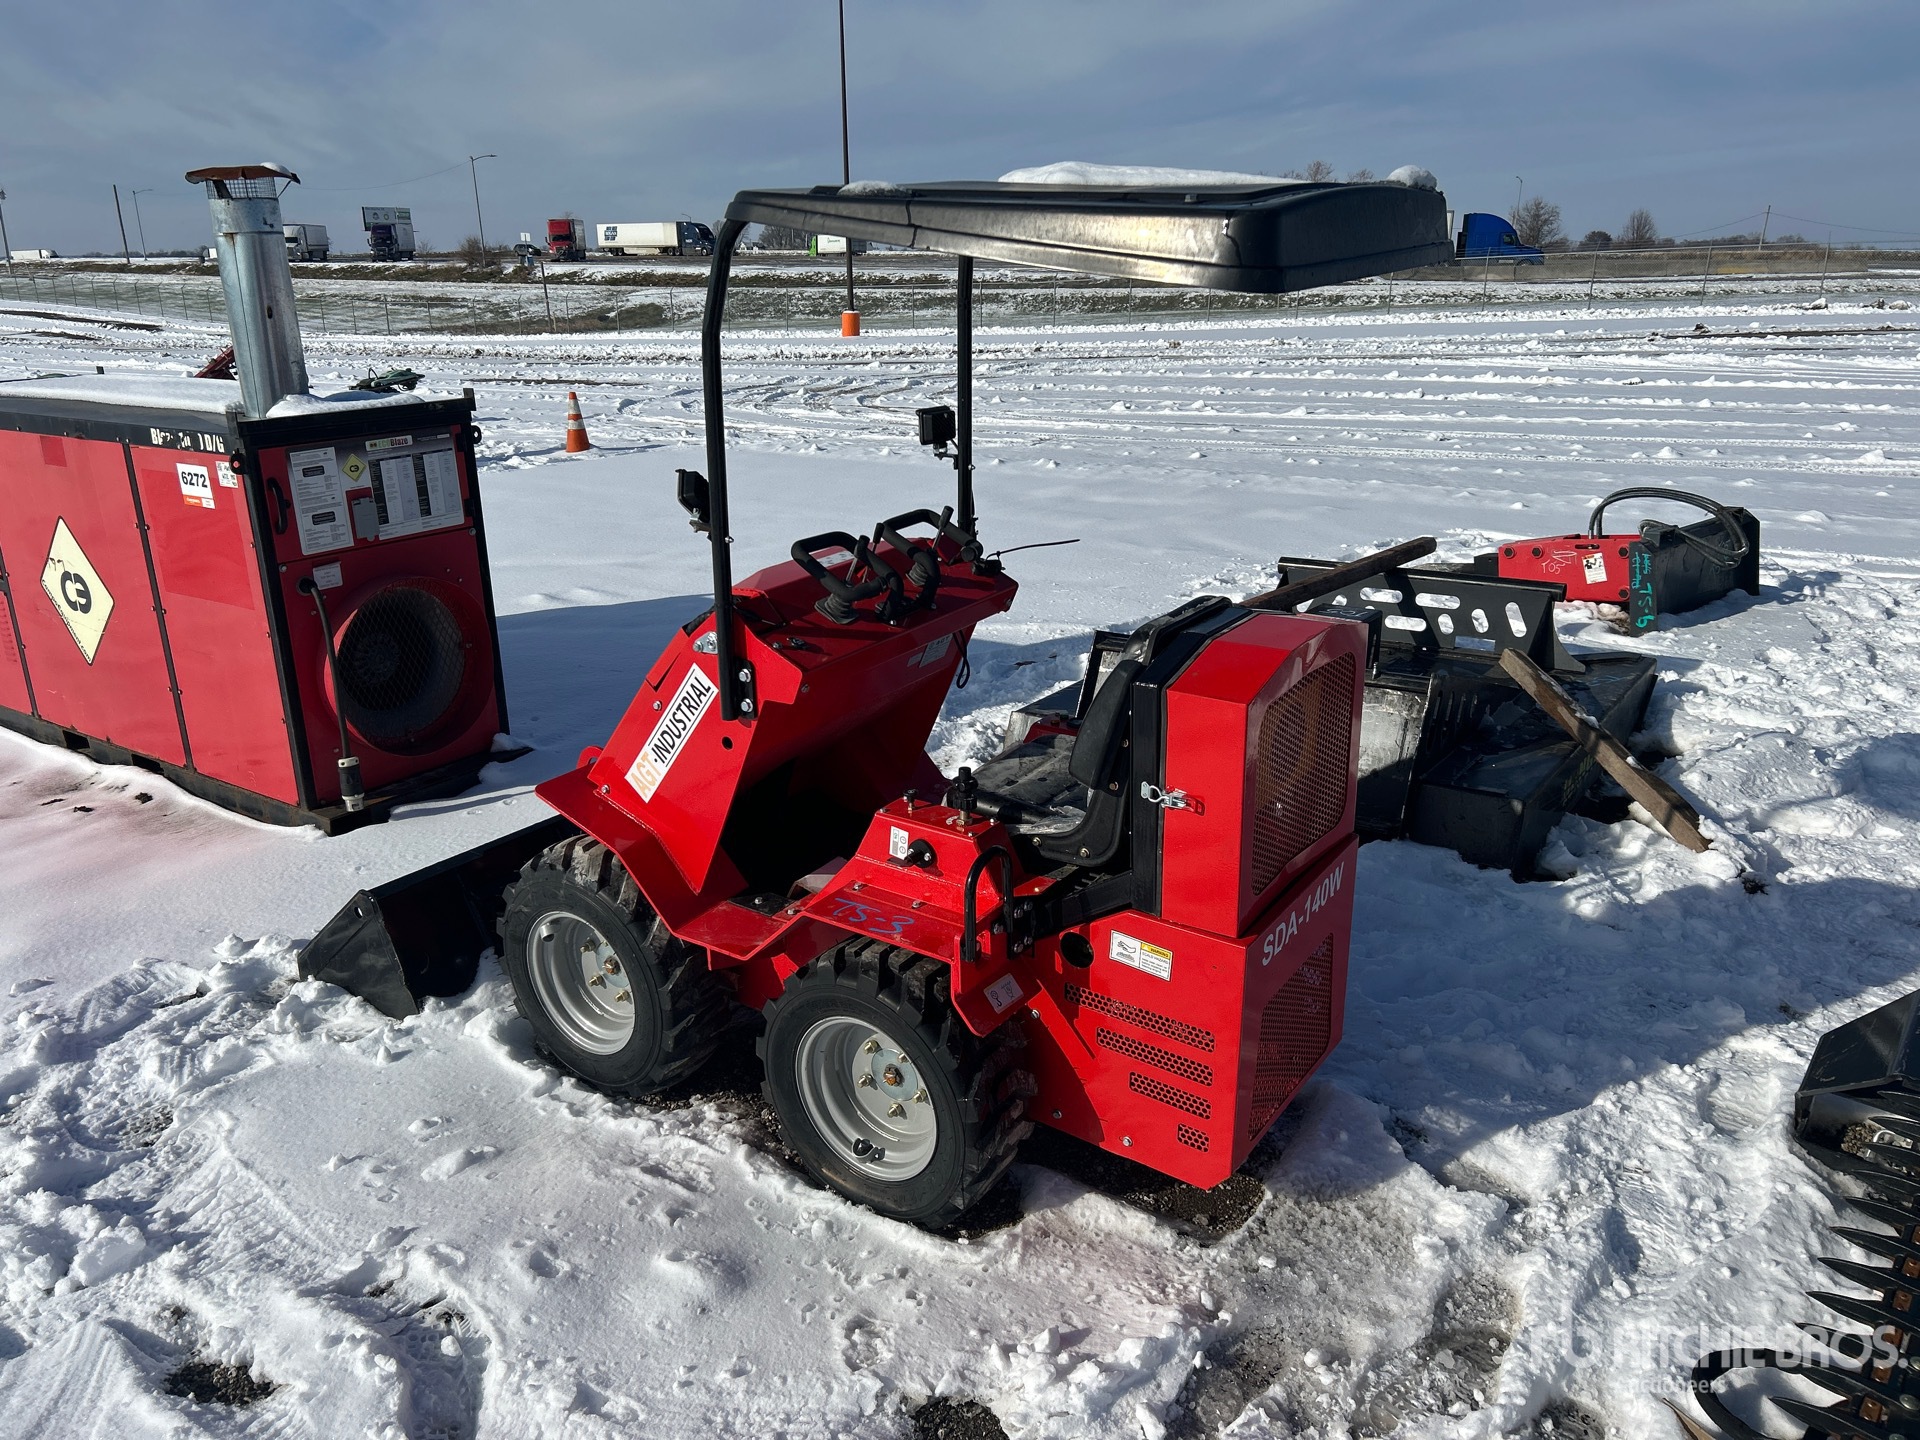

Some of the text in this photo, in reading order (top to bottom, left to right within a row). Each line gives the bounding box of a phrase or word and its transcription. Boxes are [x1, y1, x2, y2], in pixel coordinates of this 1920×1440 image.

[181, 471, 208, 488] 6272
[630, 751, 662, 798] AGT
[832, 897, 915, 935] TS-3
[1262, 861, 1344, 966] SDA-140W
